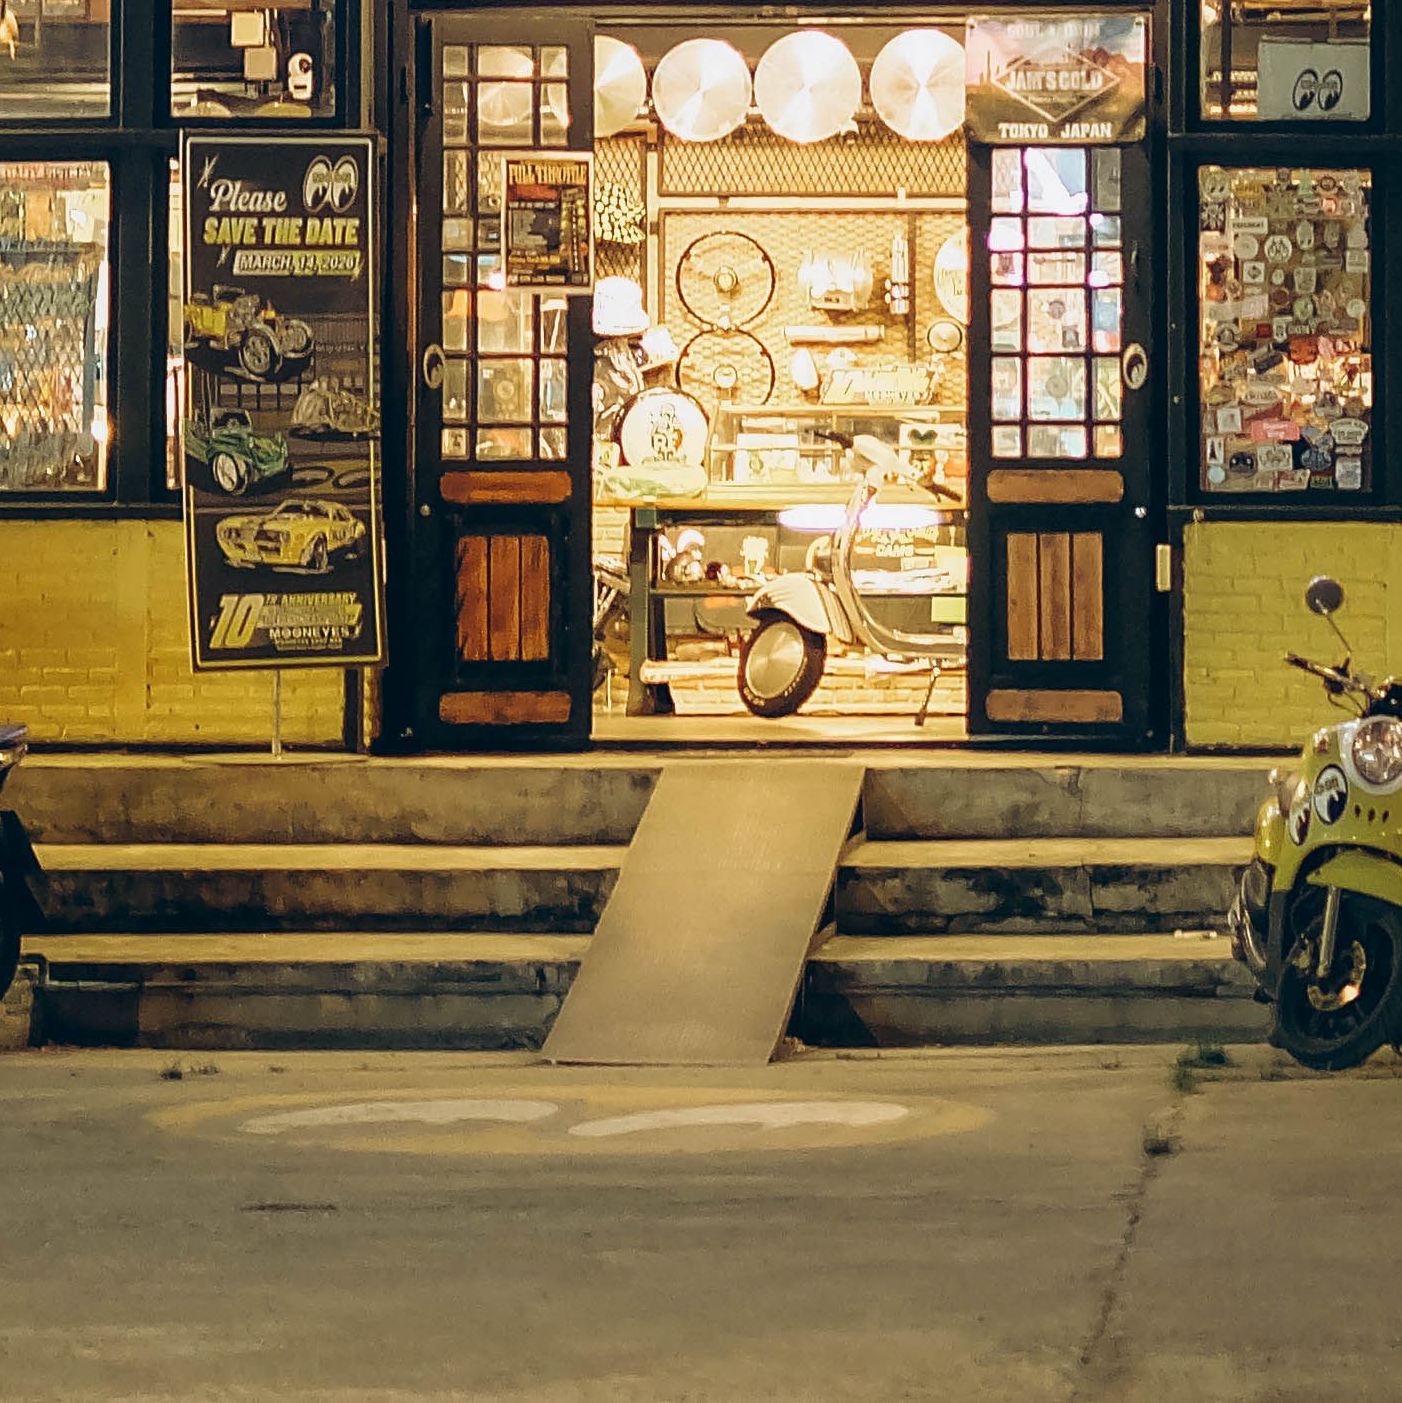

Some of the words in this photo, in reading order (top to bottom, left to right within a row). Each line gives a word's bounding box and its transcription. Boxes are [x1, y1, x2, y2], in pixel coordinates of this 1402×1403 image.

[998, 123, 1049, 139] TOKYO
[1060, 122, 1112, 139] JAPAN
[208, 179, 287, 213] Please
[204, 216, 258, 245] SAVE
[262, 216, 303, 245] THE
[305, 216, 360, 245] DATE
[321, 254, 355, 272] 2020
